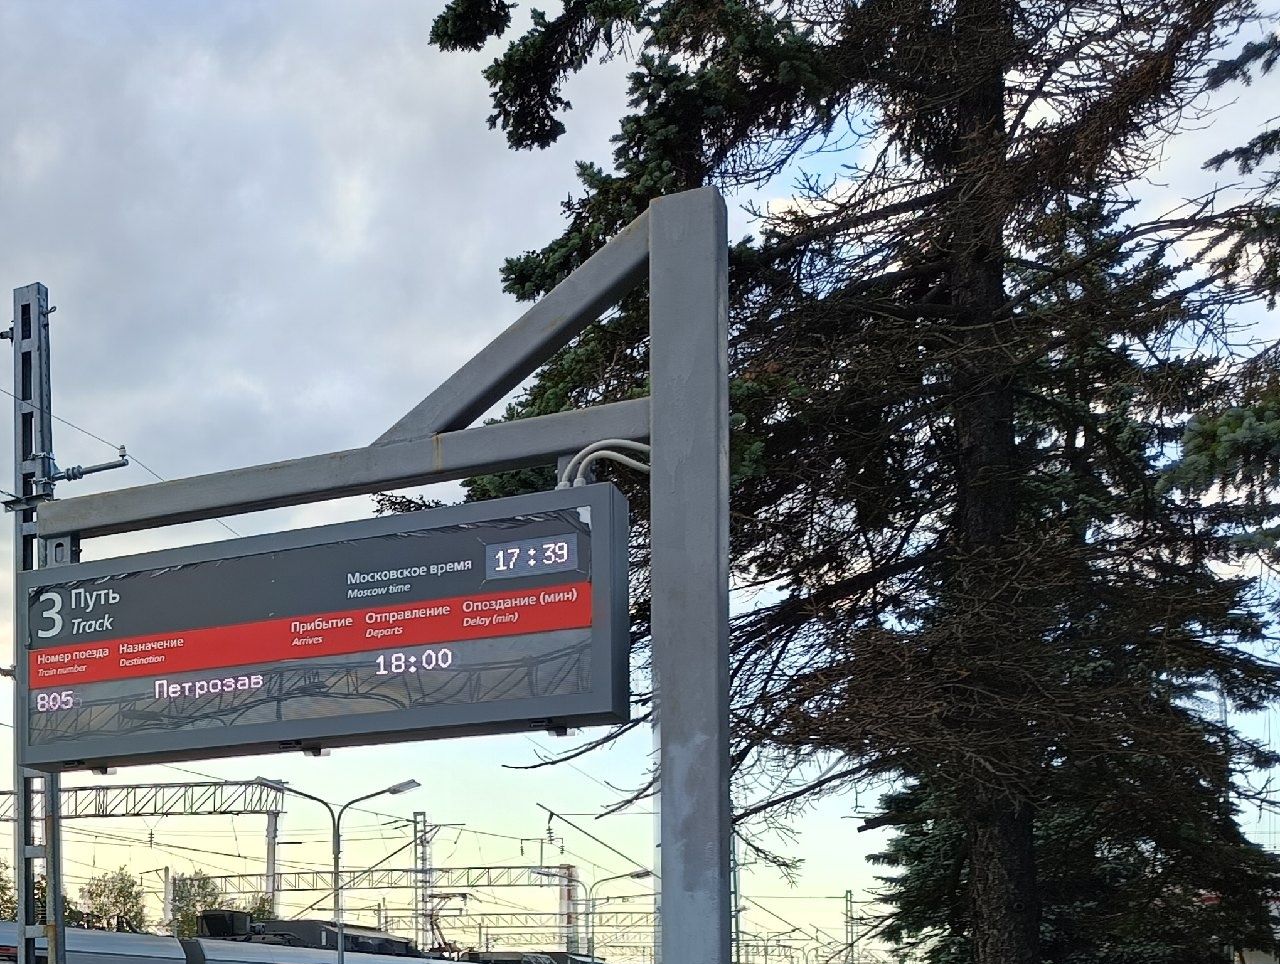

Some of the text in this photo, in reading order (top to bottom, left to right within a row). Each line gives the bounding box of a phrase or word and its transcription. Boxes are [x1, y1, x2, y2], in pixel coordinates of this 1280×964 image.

[495, 542, 568, 571] 17:39
[347, 560, 472, 585] Московское время
[71, 588, 120, 612] Путь
[347, 583, 411, 598] Moscow time
[462, 588, 577, 612] Опоздание (мин)
[37, 592, 63, 638] 3
[365, 605, 451, 624] Отправление
[463, 612, 518, 627] Delay (min)
[71, 614, 114, 635] Track
[291, 616, 353, 635] Прибытие
[365, 626, 403, 639] Departs
[119, 637, 184, 654] Назначение
[292, 636, 323, 646] Arrives
[37, 647, 109, 665] Номер поезда
[120, 654, 165, 667] Destination
[375, 649, 452, 675] 18:00
[38, 665, 87, 677] Train number
[154, 674, 264, 699] Петрозав
[37, 691, 74, 712] 805
